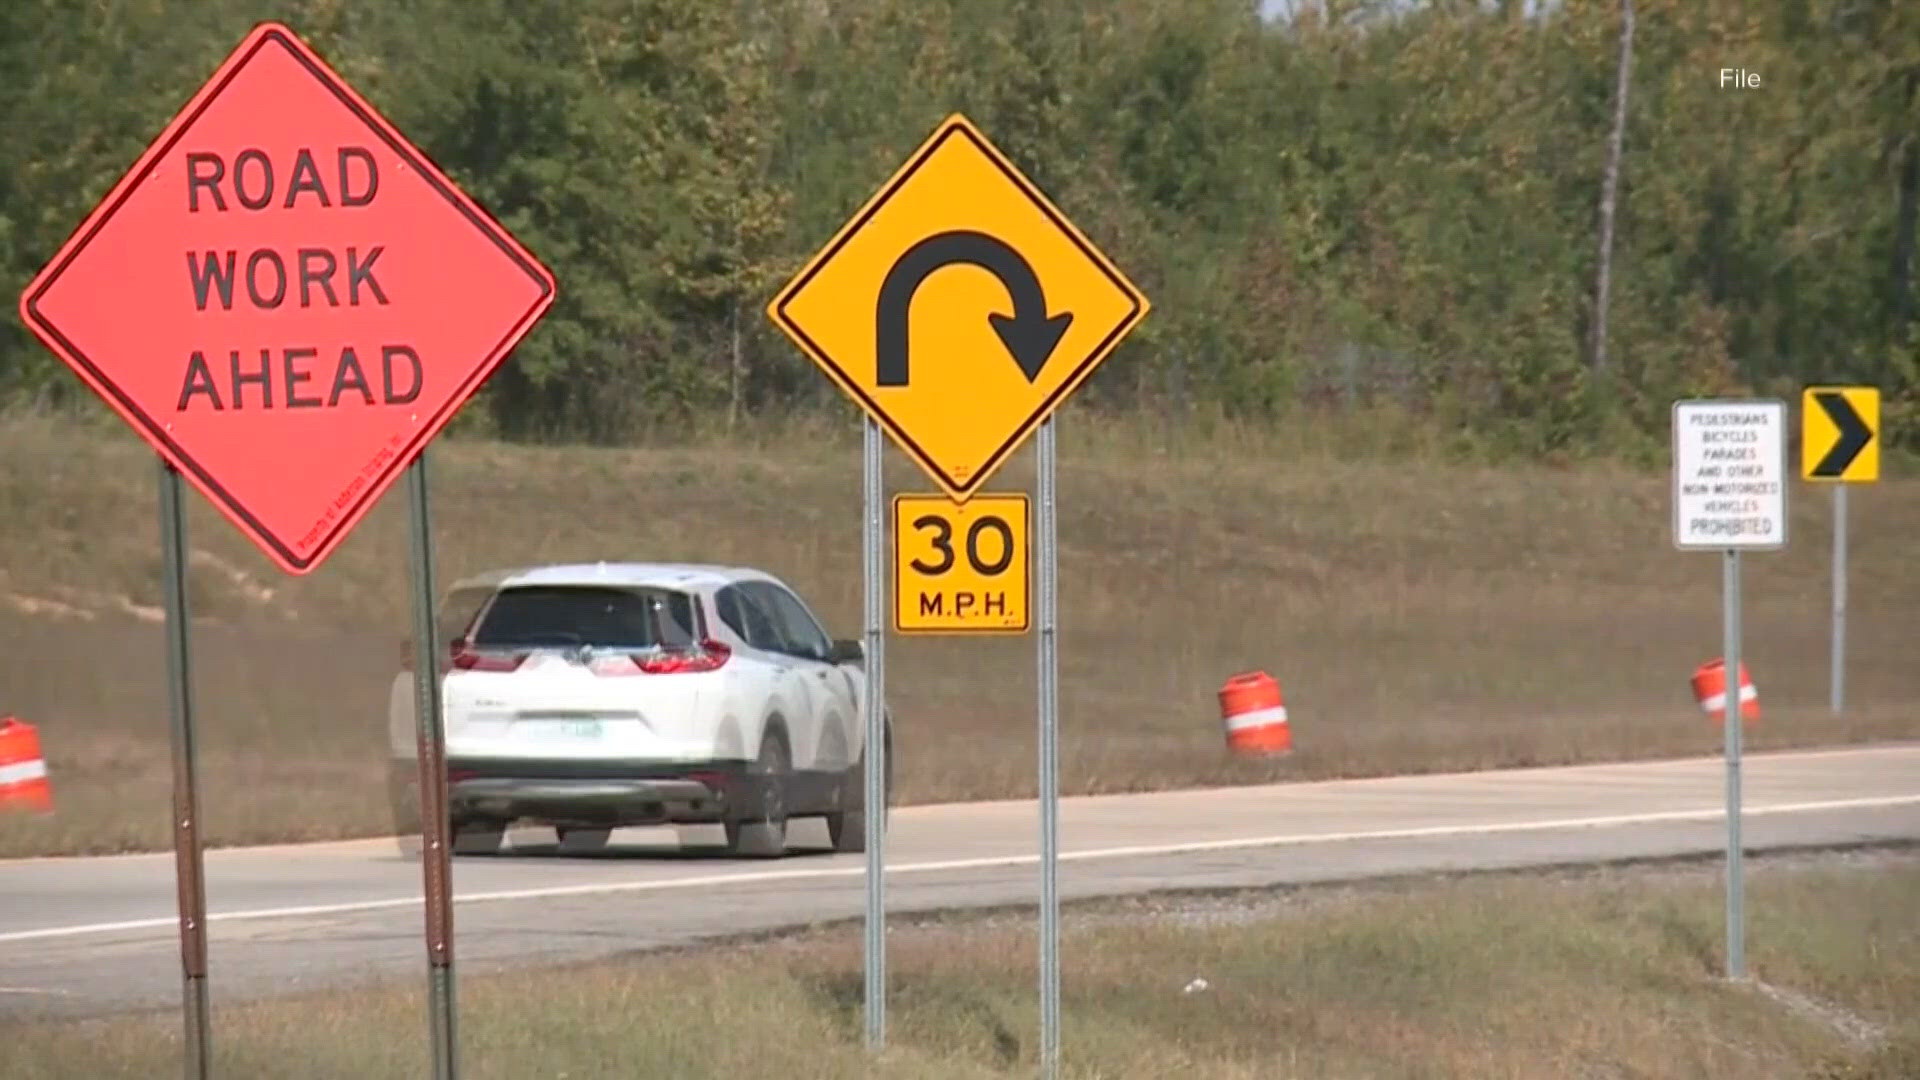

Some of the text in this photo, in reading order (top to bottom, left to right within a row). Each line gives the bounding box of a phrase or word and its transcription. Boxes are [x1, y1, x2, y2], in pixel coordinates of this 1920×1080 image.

[186, 147, 379, 213] ROAD
[186, 246, 390, 311] WORK
[177, 345, 423, 412] AHEAD
[1690, 413, 1768, 426] PEDESTRIANS
[1702, 430, 1758, 443] BICYCLES
[1703, 447, 1757, 460] PARADES
[1698, 465, 1763, 478] AND OTHER
[1704, 500, 1759, 513] VEHICLES
[1690, 517, 1772, 535] PROHIBITED
[910, 515, 1014, 576] 30
[920, 592, 1013, 618] M.P.H.
